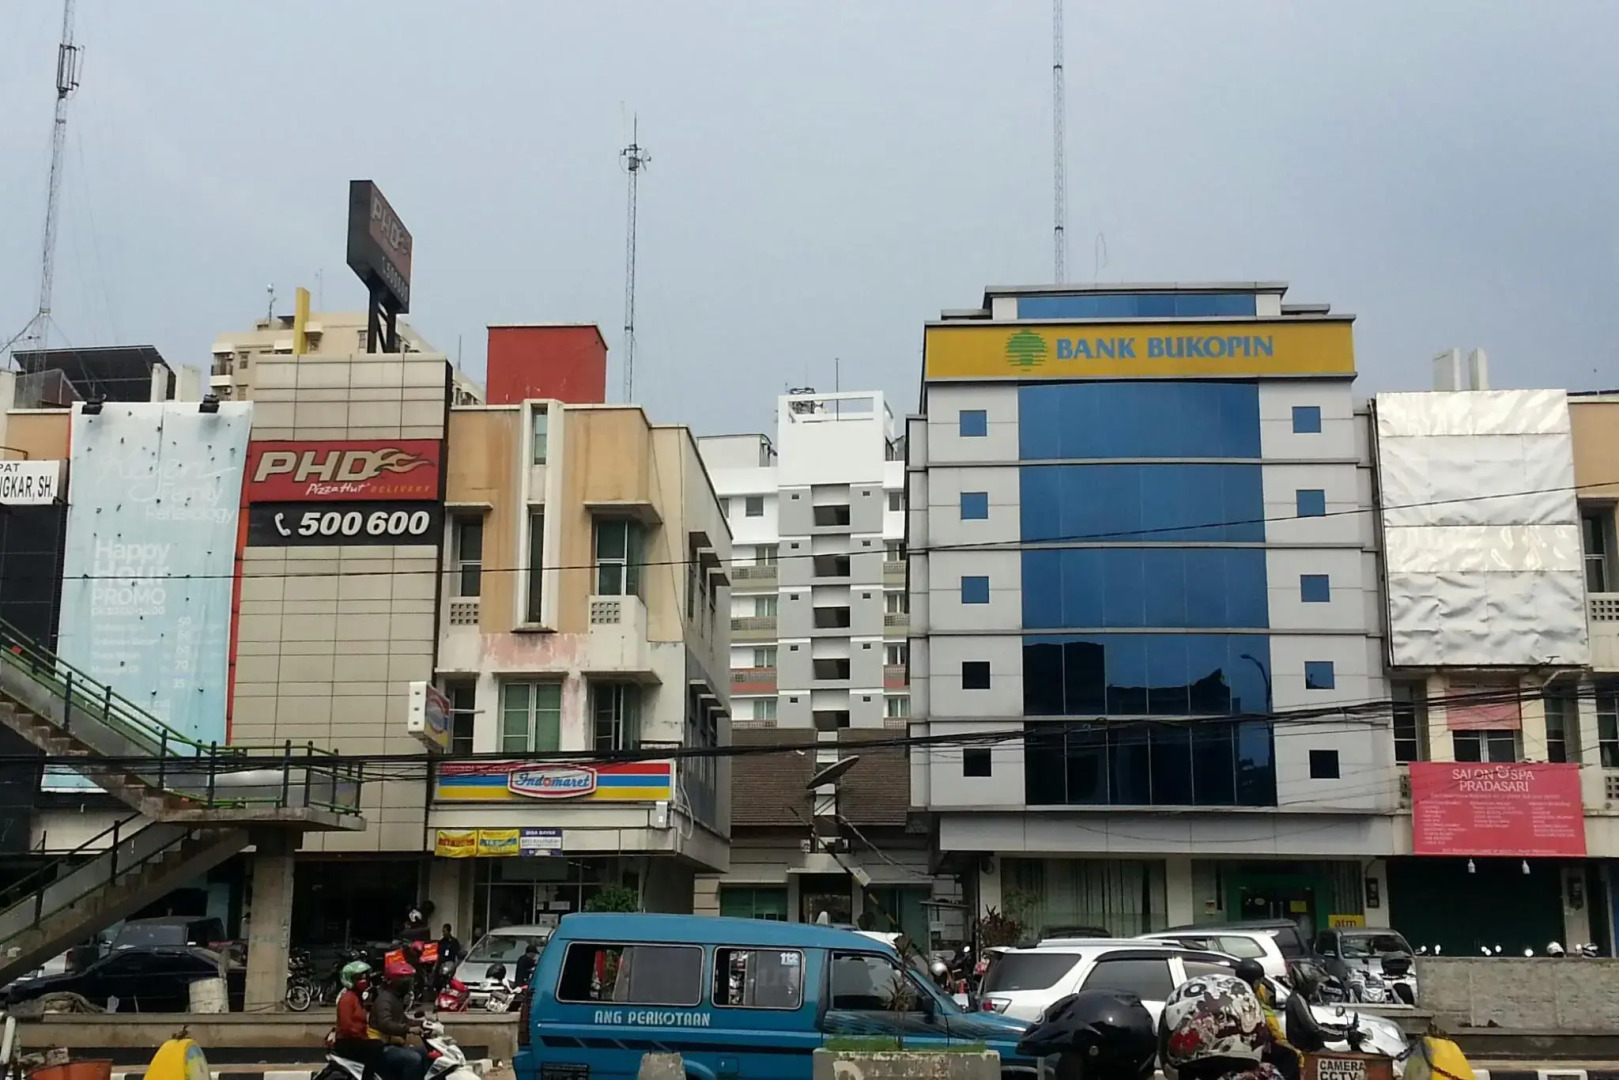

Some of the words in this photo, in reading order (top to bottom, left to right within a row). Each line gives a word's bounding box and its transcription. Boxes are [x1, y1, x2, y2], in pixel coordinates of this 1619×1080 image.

[1055, 338, 1137, 359] BANK
[1146, 335, 1274, 358] BUKOPIN
[253, 450, 382, 482] PHD
[305, 483, 339, 496] Pizza
[340, 482, 366, 493] Hut
[95, 539, 171, 565] Happy
[92, 561, 170, 586] Hour
[92, 588, 166, 606] PROMO
[515, 773, 590, 787] Indomaret
[1510, 769, 1535, 781] SPA
[1459, 781, 1529, 792] PRADASARI
[1334, 918, 1357, 928] atm
[594, 1010, 622, 1024] ANG
[627, 1011, 711, 1026] PERKOTAAN
[1319, 1060, 1367, 1071] CAMERA
[1319, 1071, 1359, 1080] CCTV
